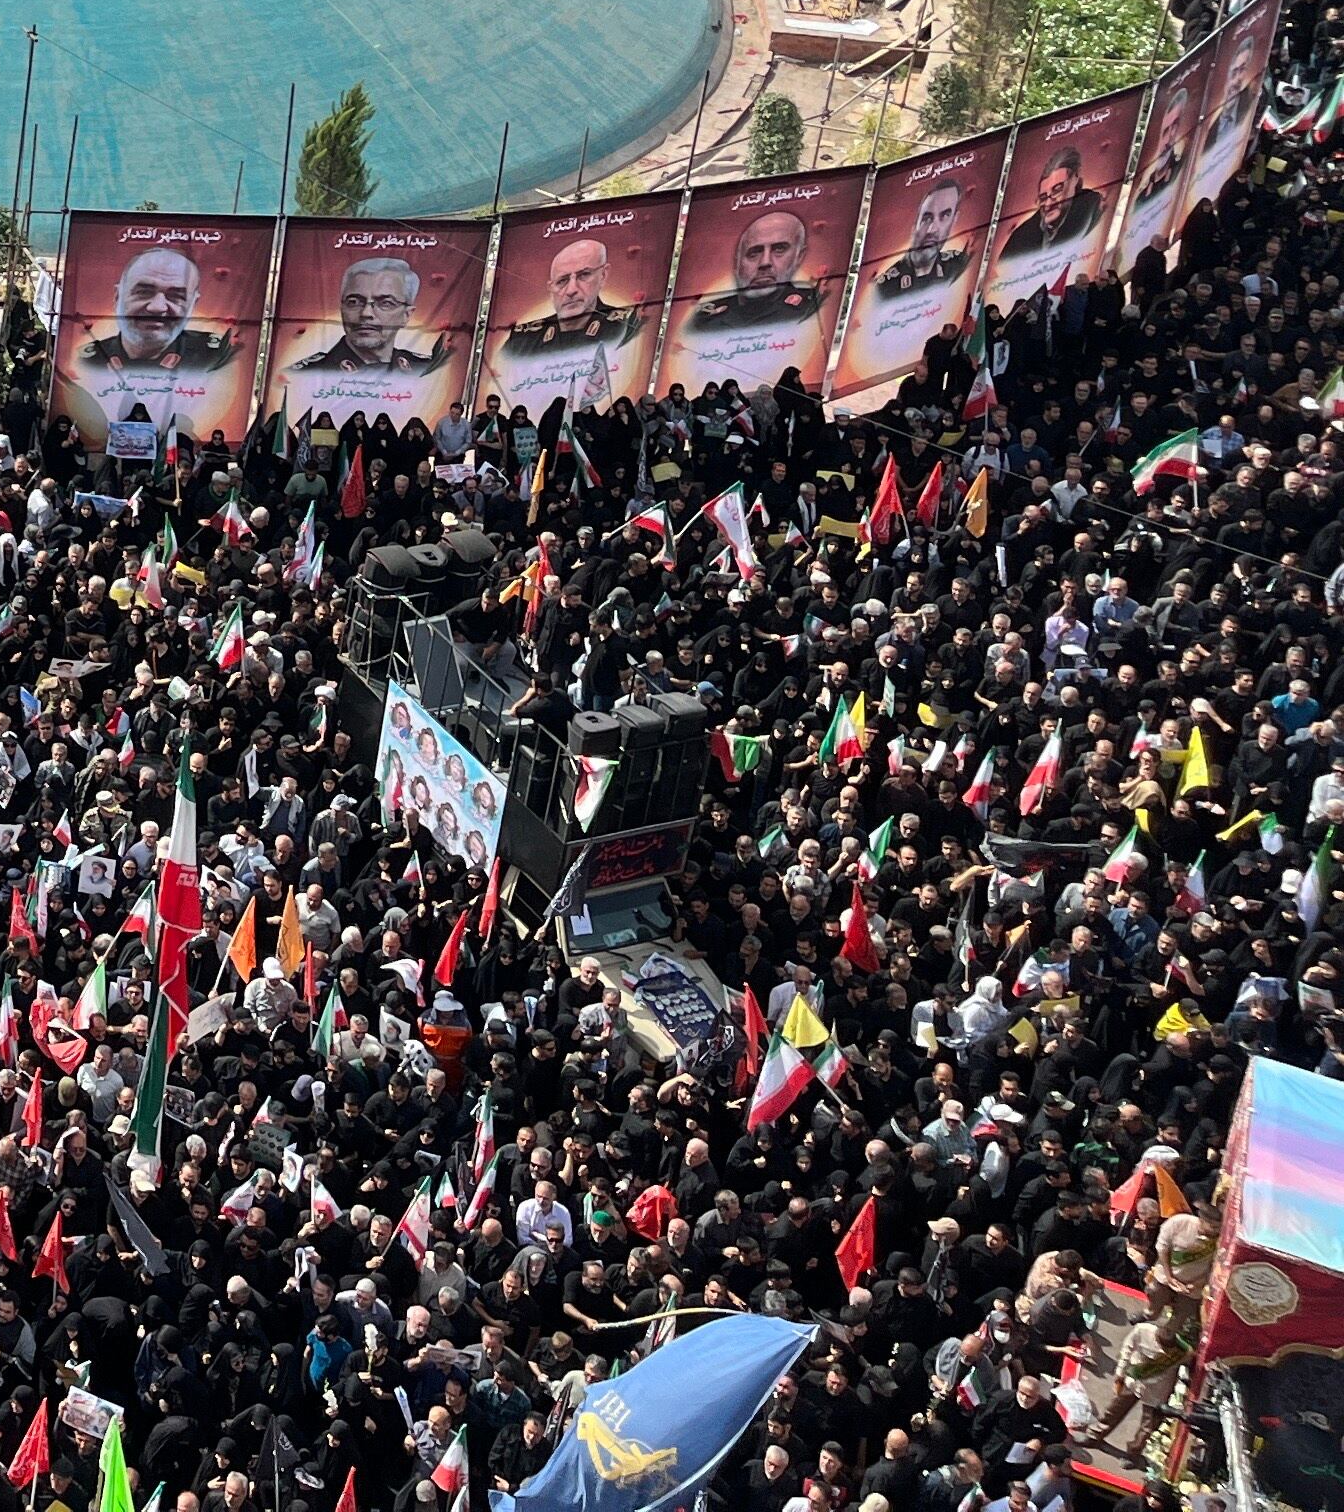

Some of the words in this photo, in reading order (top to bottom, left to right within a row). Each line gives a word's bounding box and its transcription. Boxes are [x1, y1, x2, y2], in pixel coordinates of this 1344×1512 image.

[955, 153, 974, 168] شهدا
[906, 167, 932, 187] اقتدار
[932, 161, 954, 179] مظهر
[765, 191, 793, 207] مظهر
[795, 186, 821, 200] شهدا
[731, 192, 765, 211] اقتدار
[577, 217, 606, 233] مظهر
[607, 211, 634, 226] شهدا
[119, 228, 157, 242] اقتدار
[159, 230, 189, 243] مظهر
[543, 220, 578, 238] اقتدار
[191, 230, 221, 244] شهدا
[334, 232, 372, 248] اقتدار
[372, 234, 405, 249] مظهر
[407, 235, 437, 249] شهدا
[724, 342, 768, 361] غلامعلی
[769, 339, 795, 351] شهید
[698, 348, 724, 361] رشید
[97, 382, 136, 397] سلامی
[510, 373, 549, 392] محرابی
[138, 385, 173, 396] حسین
[175, 385, 205, 396] شهید
[312, 386, 346, 399] باقری
[345, 390, 380, 400] محمد
[382, 389, 413, 400] شهید
